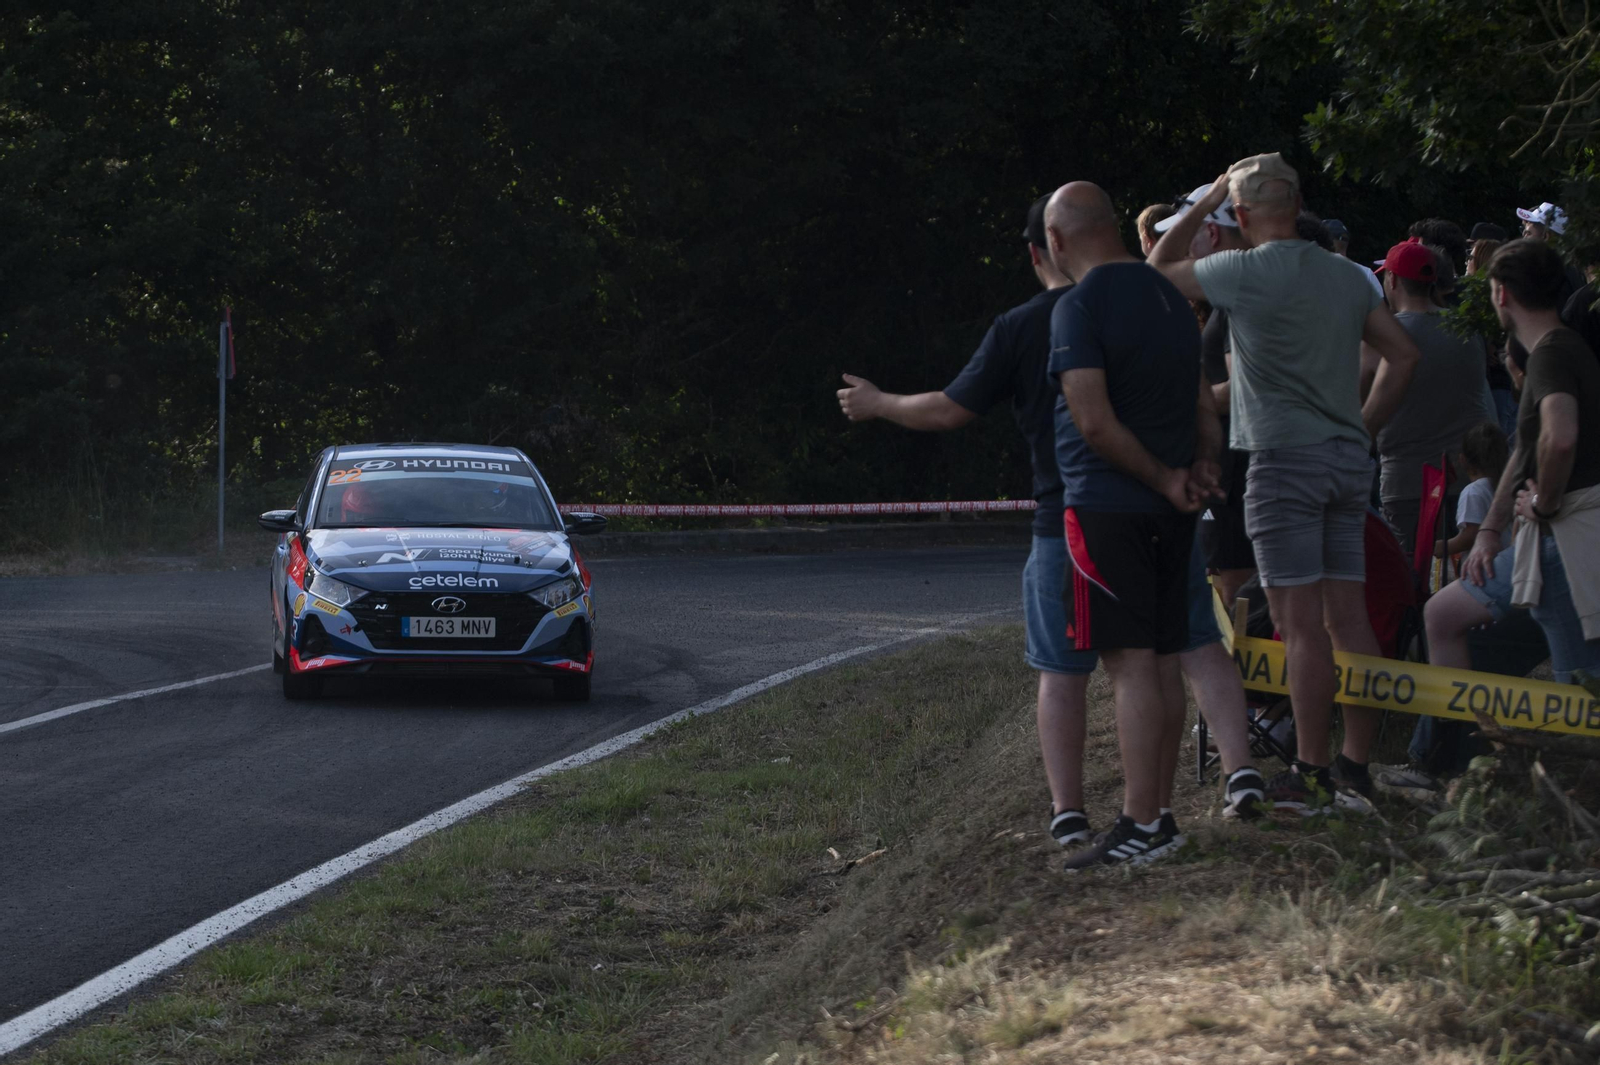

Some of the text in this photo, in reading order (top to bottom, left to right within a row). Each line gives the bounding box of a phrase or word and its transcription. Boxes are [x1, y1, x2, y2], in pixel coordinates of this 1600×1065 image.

[402, 459, 511, 472] HYUNDAI
[329, 469, 362, 484] 22
[408, 573, 499, 589] cetelem
[314, 600, 339, 615] PIRELLI
[556, 603, 578, 617] PIRELLI
[415, 619, 455, 635] 1463
[461, 619, 492, 635] MNV
[1447, 681, 1534, 722] ZONA
